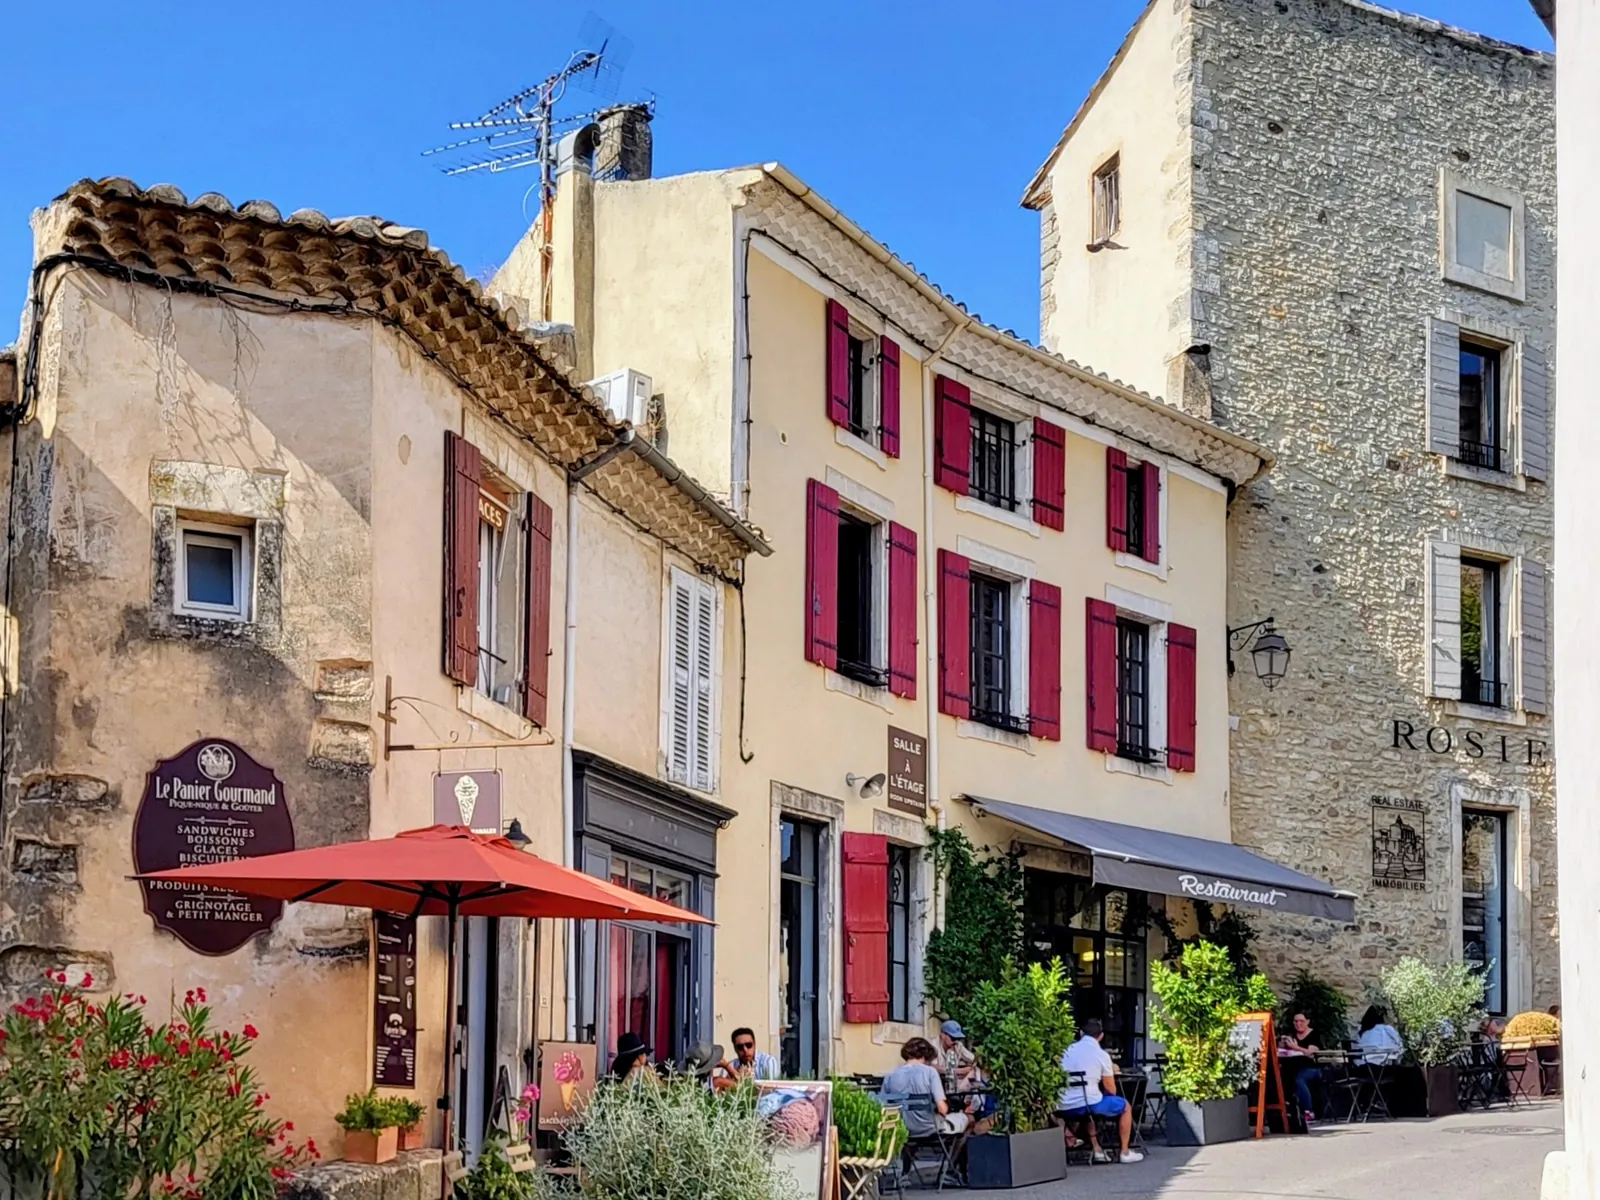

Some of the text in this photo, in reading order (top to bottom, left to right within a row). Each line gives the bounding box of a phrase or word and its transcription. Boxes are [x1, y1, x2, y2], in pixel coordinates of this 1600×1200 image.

[893, 737, 921, 755] SALLE
[904, 759, 911, 773] À
[156, 776, 276, 806] Le Panier Gourmand
[890, 774, 925, 795] L'ÉTAGE
[221, 802, 229, 810] &
[1371, 795, 1425, 809] REAL ESTATE
[177, 825, 255, 838] SANDWICHES
[187, 835, 245, 846] BOISSONS
[194, 845, 239, 855] GLACES
[1178, 874, 1287, 905] Restaurant
[1372, 878, 1426, 890] IMMOBILIER
[175, 900, 251, 912] GRIGNOTAGE
[178, 910, 210, 920] PETIT
[214, 911, 263, 922] MANGER
